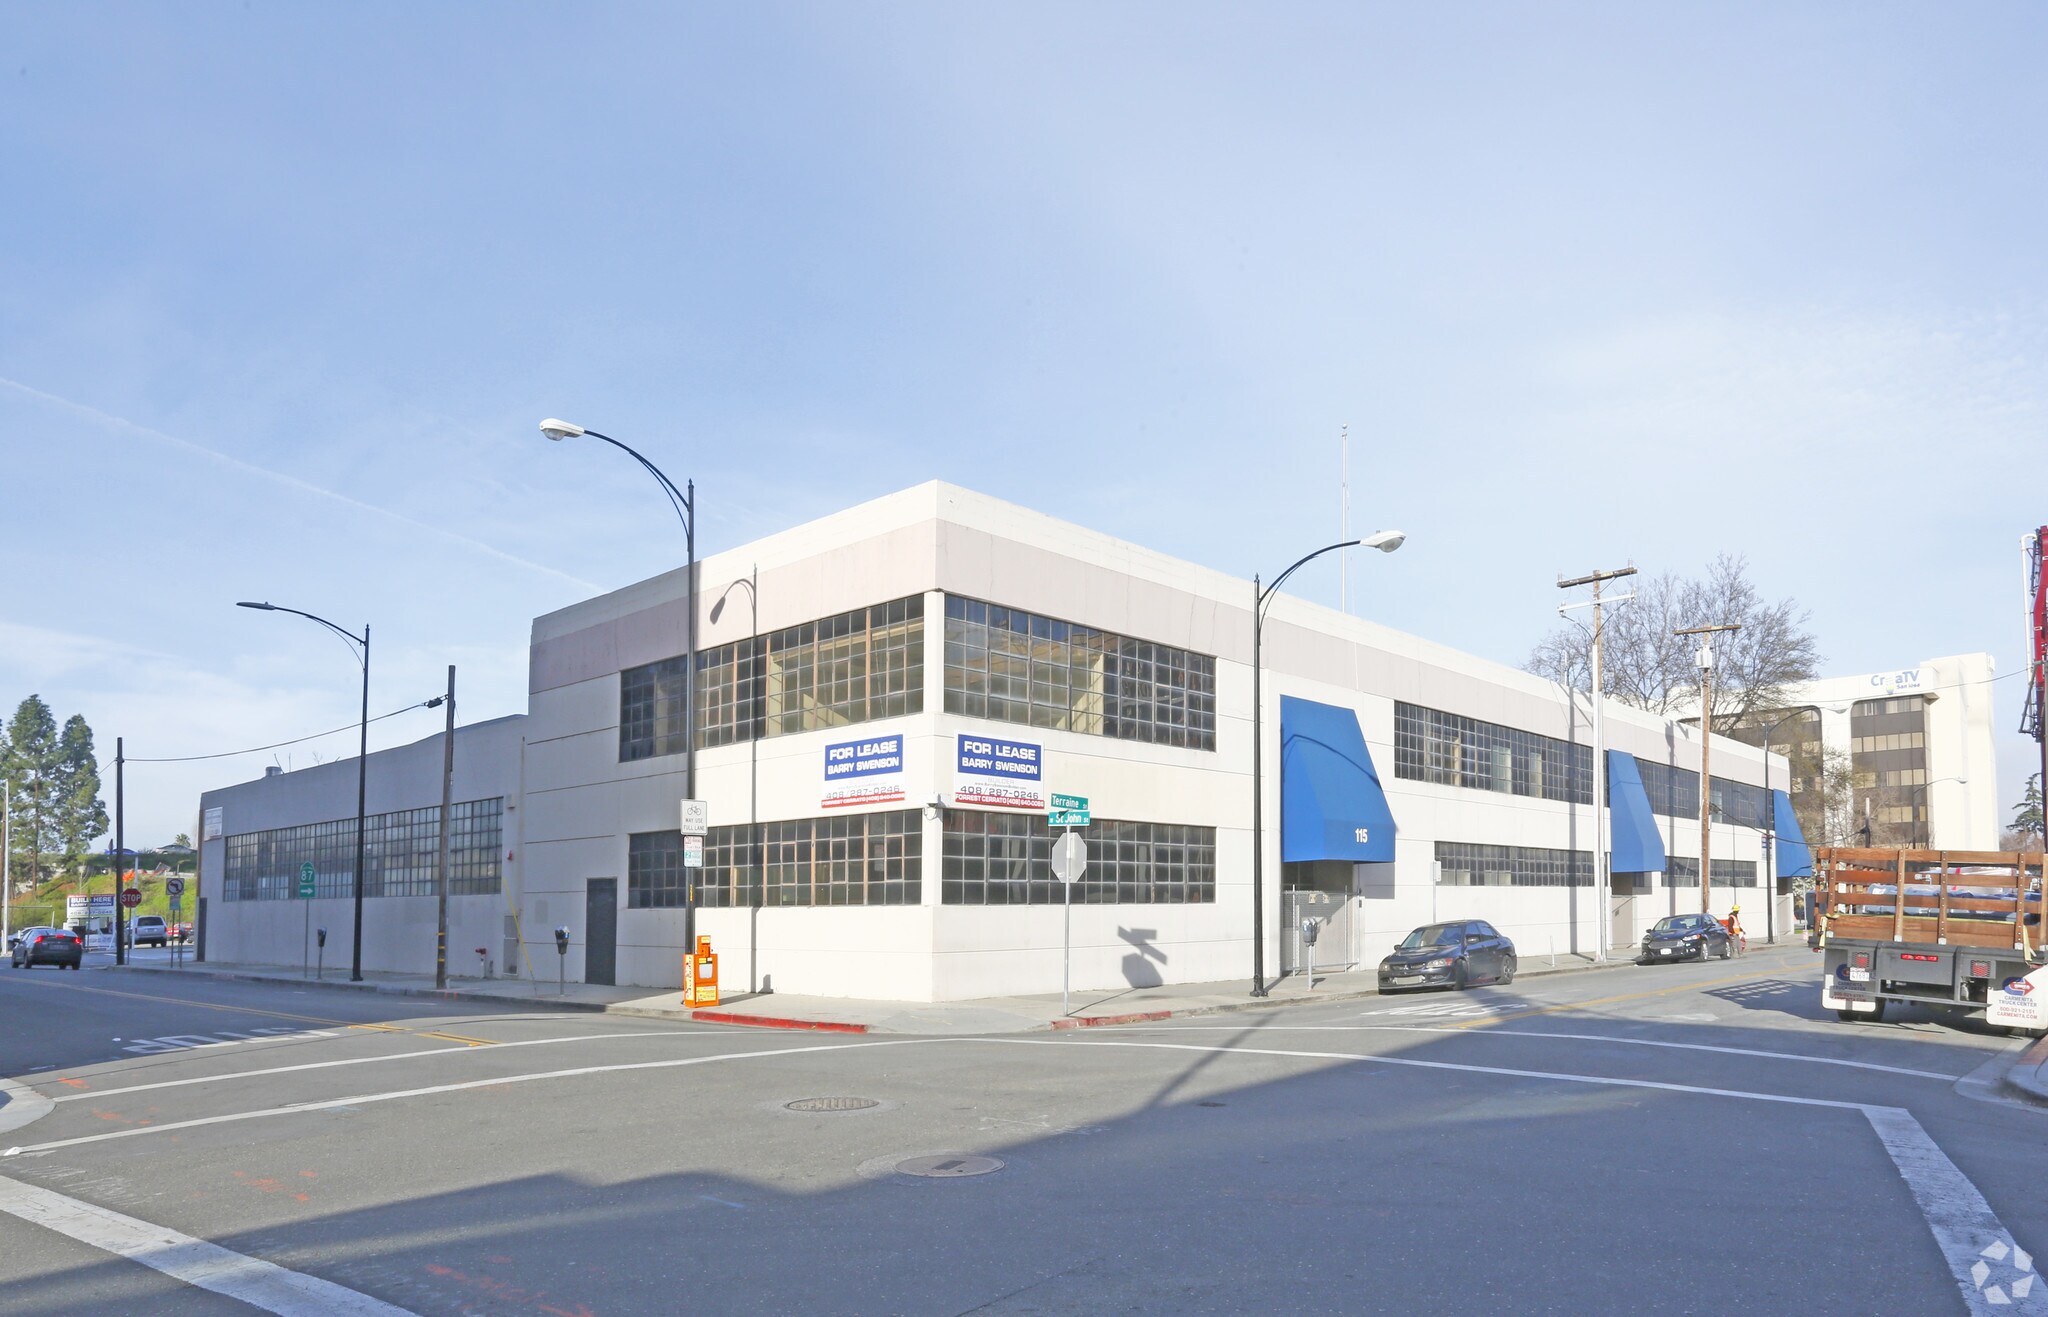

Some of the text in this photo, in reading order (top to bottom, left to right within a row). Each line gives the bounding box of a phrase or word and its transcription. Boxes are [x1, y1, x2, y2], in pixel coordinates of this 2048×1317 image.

[830, 740, 898, 761] FOR LEASE
[964, 740, 1036, 760] FOR LEASE
[827, 756, 899, 775] BARRY SWENSON
[961, 757, 1038, 775] BARRY SWENSON
[960, 785, 1039, 800] 408/287-0246
[1052, 795, 1079, 808] Terraine
[1065, 813, 1082, 823] John
[1355, 828, 1368, 843] 115
[301, 870, 313, 881] 87
[122, 893, 141, 902] STOP
